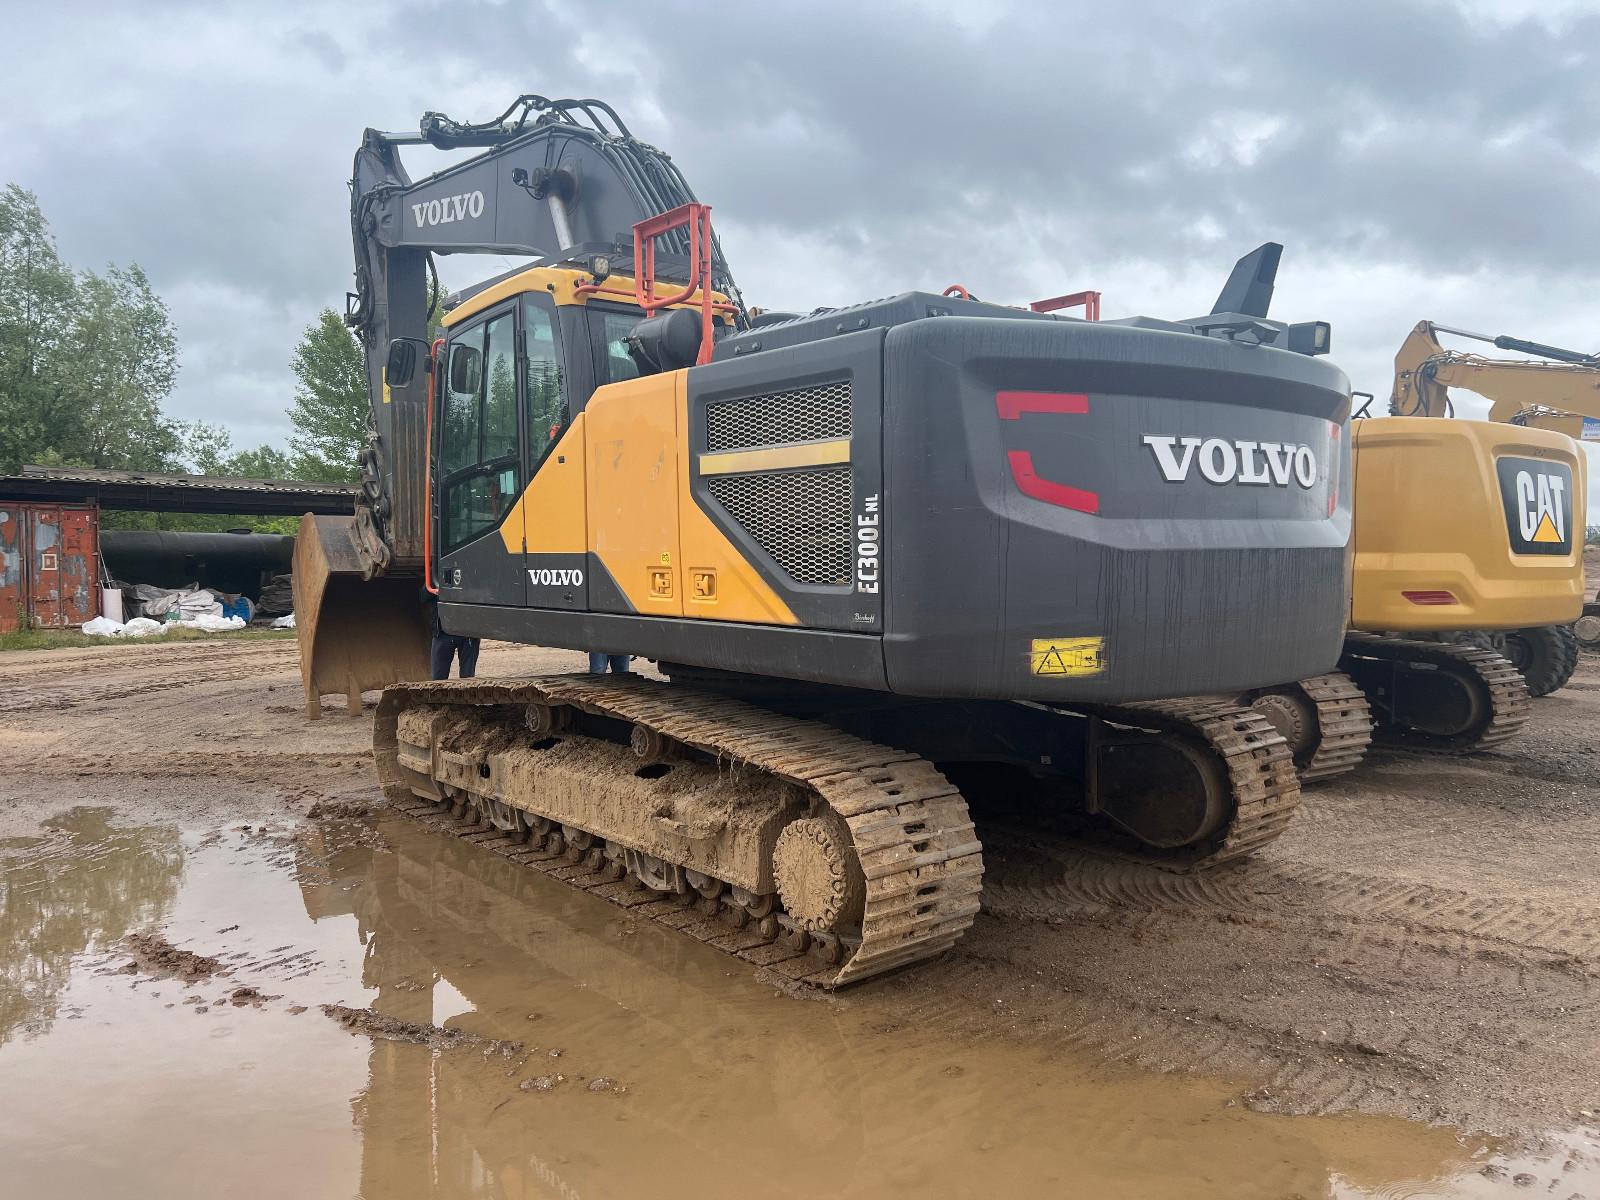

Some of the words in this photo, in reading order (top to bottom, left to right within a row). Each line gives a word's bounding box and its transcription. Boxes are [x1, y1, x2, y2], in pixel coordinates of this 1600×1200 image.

[412, 190, 484, 228] VOLVO
[1143, 435, 1317, 487] VOLVO
[1516, 470, 1565, 542] CAT
[528, 569, 584, 586] VOLVO
